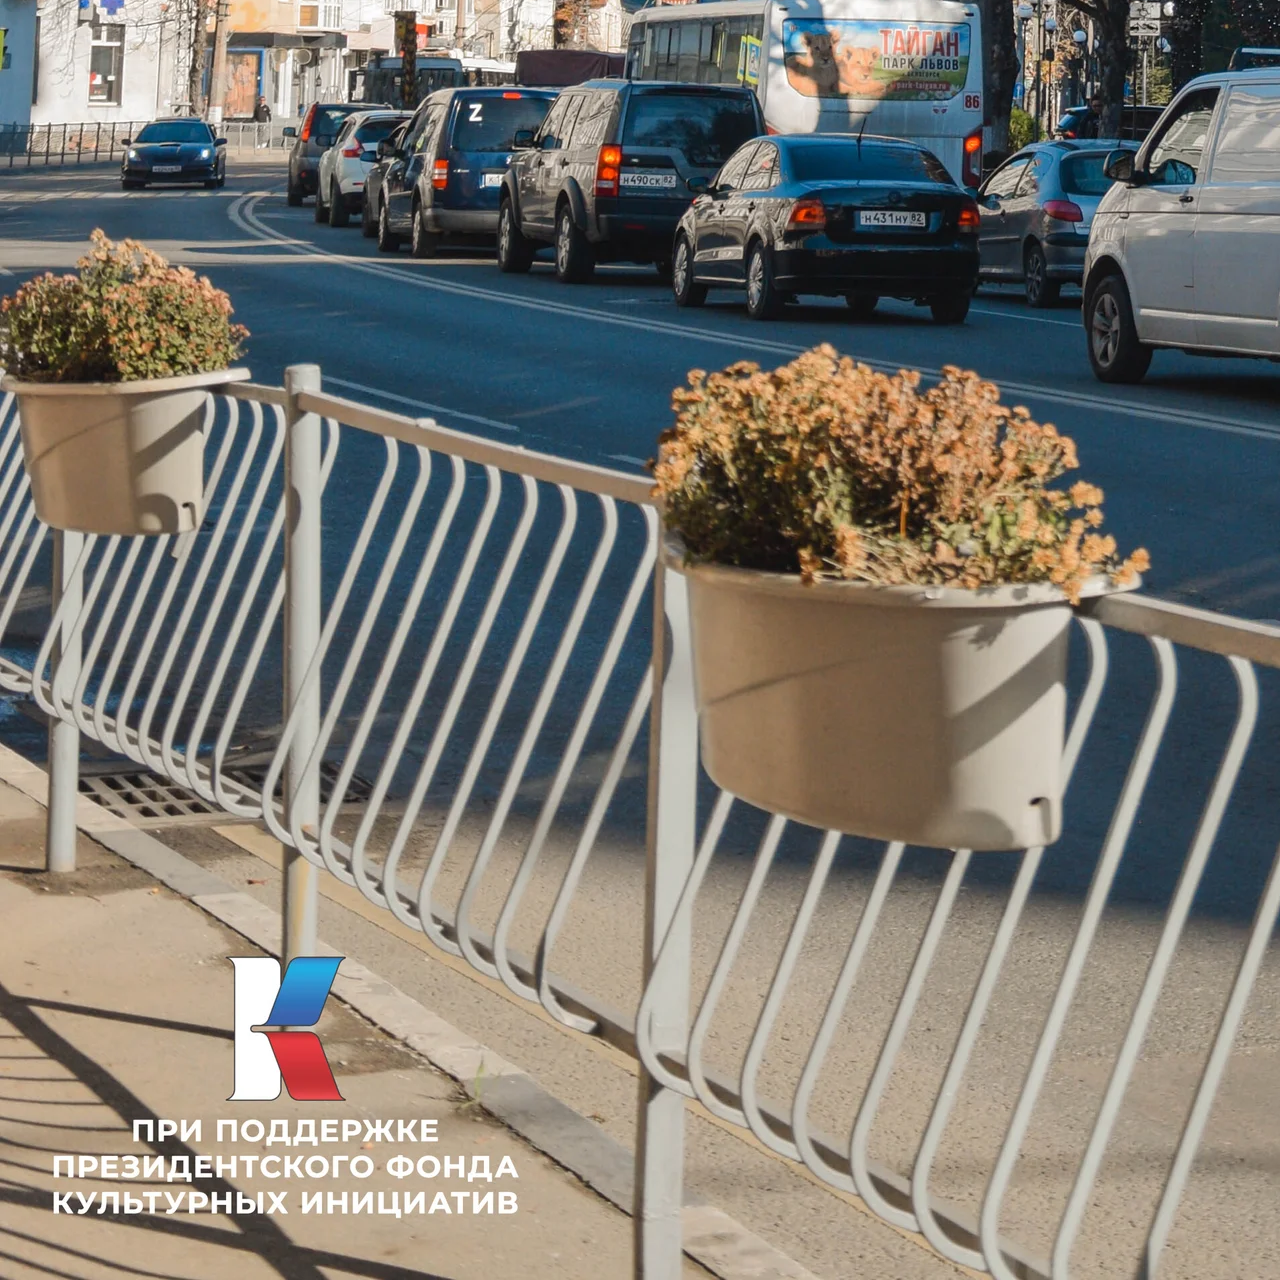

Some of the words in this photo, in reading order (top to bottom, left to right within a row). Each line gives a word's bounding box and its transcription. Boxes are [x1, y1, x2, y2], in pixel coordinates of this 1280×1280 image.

[879, 26, 959, 57] ТАЙГАН
[883, 57, 915, 69] ПАРК
[919, 58, 959, 71] ЛЬВОВ
[896, 81, 947, 91] park-taigan.ru
[964, 94, 980, 109] 86
[469, 103, 483, 122] Z
